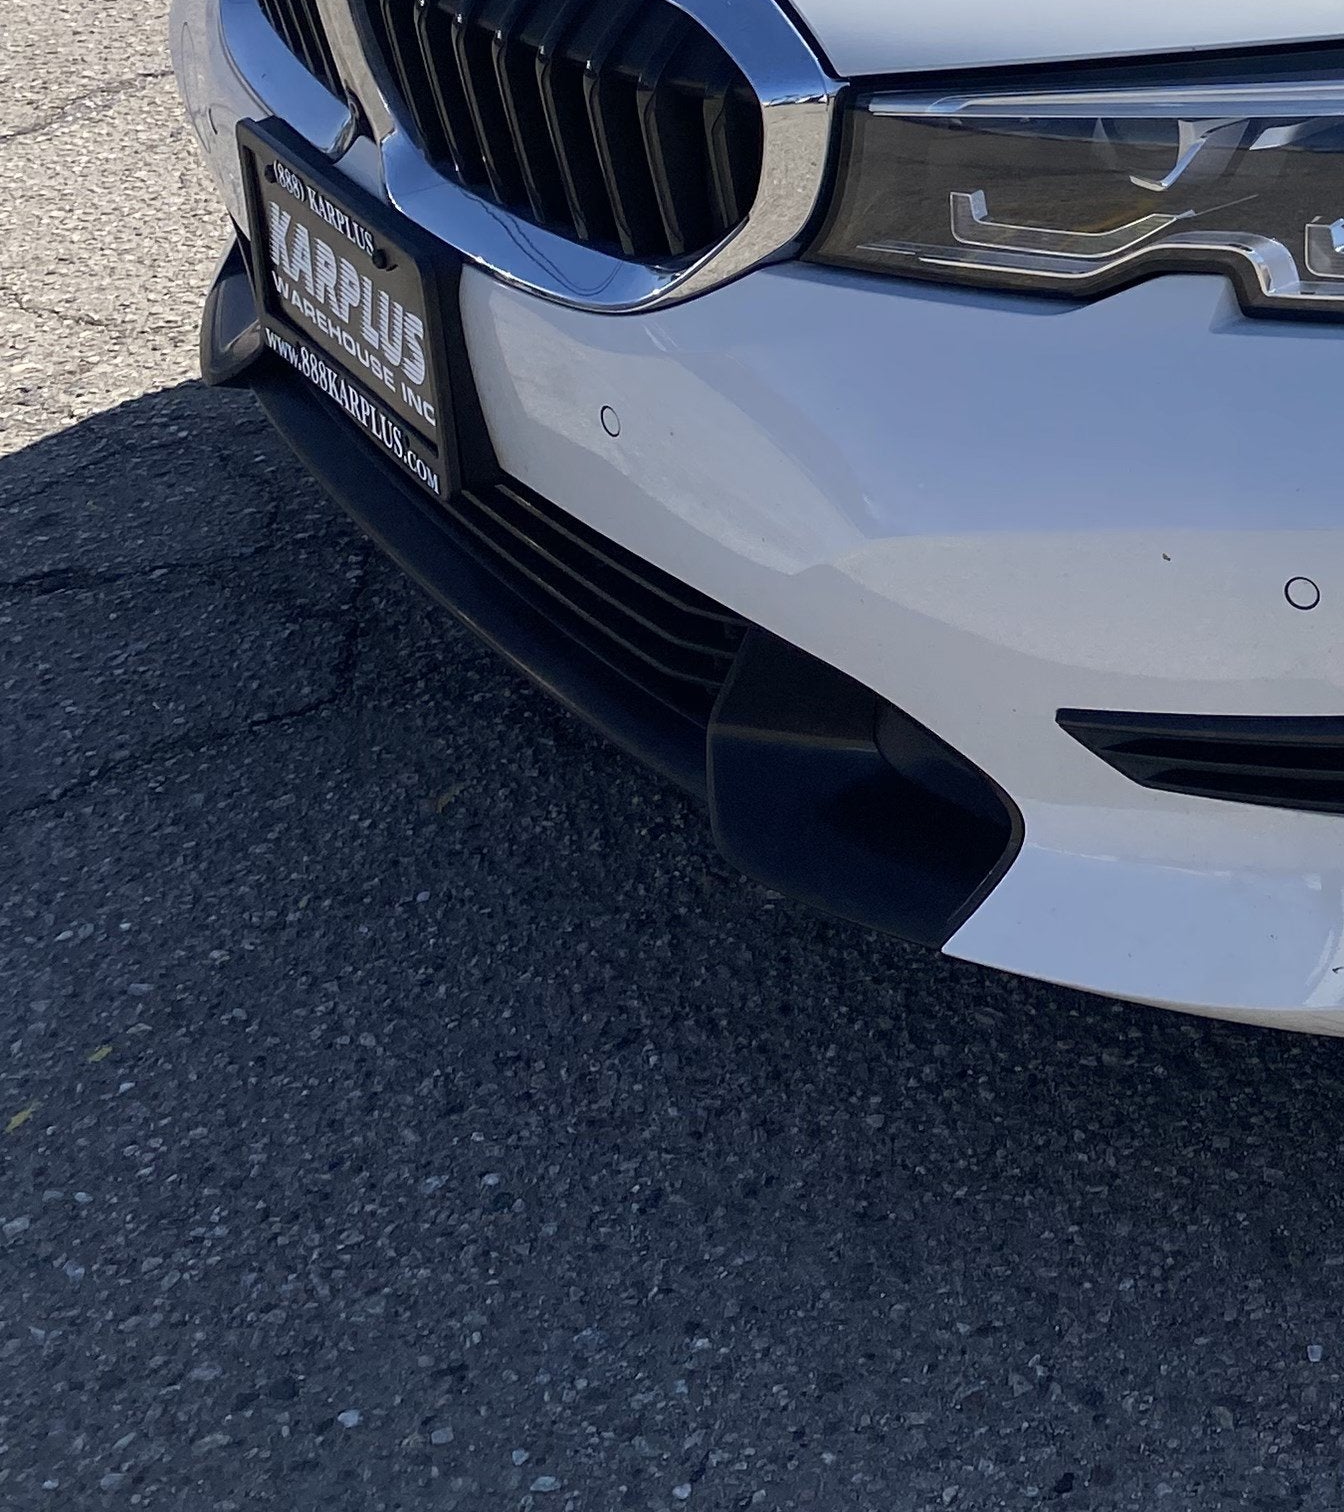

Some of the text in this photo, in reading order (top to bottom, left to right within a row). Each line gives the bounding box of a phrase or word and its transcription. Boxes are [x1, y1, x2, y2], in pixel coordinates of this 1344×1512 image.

[268, 200, 426, 386] KARPLUS
[306, 186, 375, 257] KARPLUS
[271, 270, 437, 428] WAREHOUSE INC
